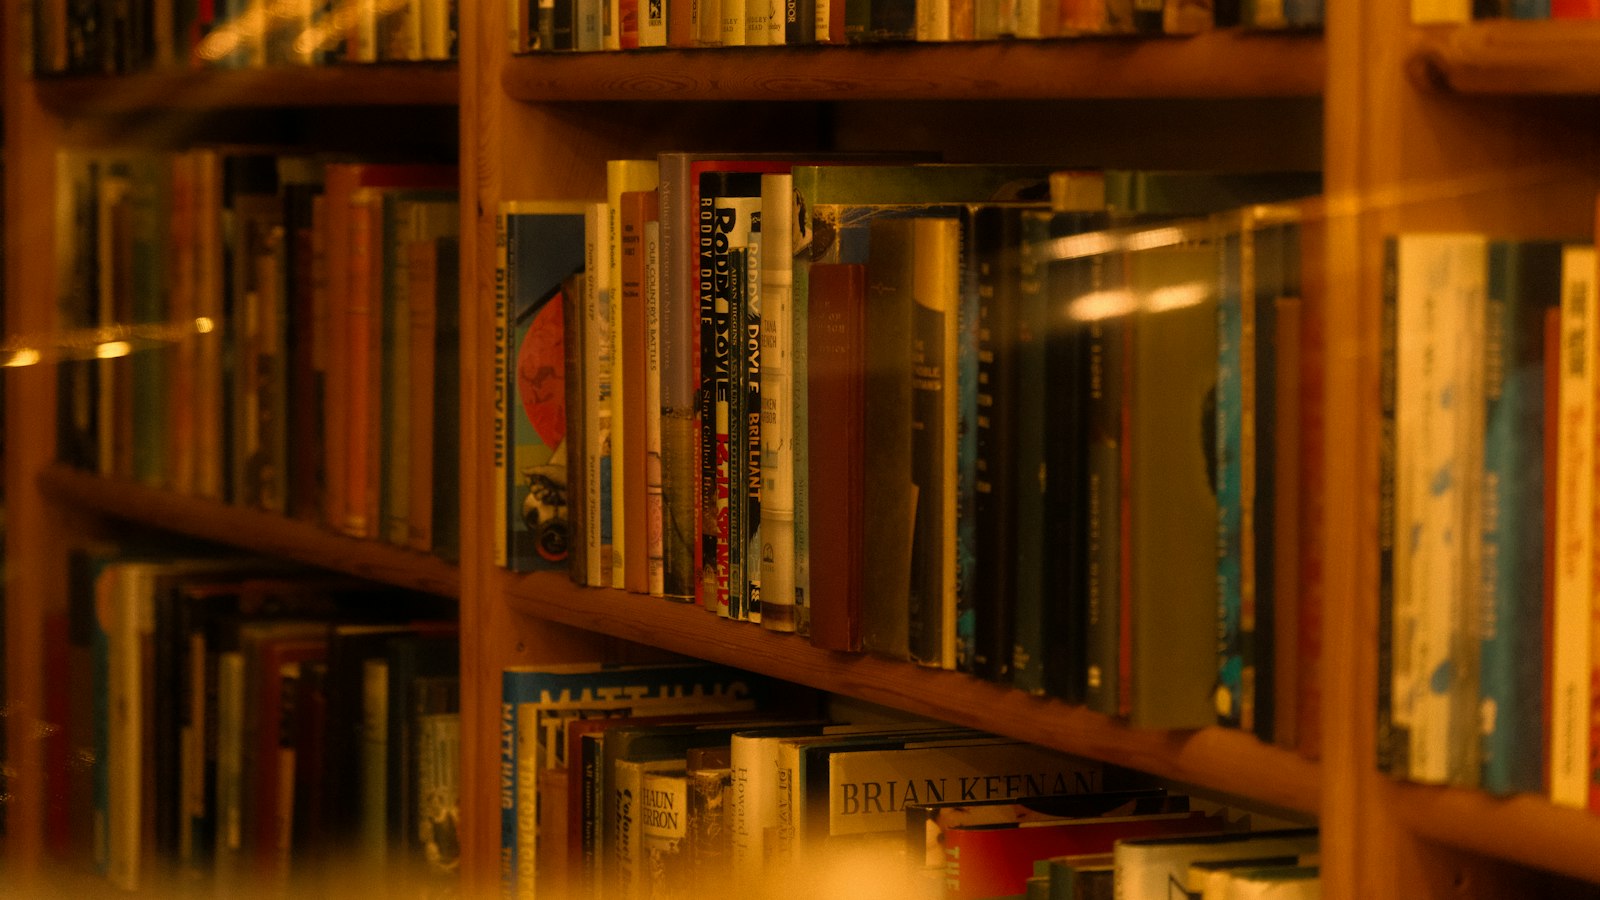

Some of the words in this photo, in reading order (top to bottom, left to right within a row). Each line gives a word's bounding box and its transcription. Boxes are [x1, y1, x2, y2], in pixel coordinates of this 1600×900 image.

[787, 0, 797, 23] DOR
[662, 180, 671, 230] Medical
[701, 197, 712, 258] RODDY
[663, 235, 671, 279] Doctor
[714, 208, 737, 299] RODDY
[701, 268, 712, 326] DOYLE
[747, 242, 759, 315] RODDY
[662, 300, 671, 335] Many
[715, 312, 730, 403] DOYLE
[747, 324, 760, 394] DOYLE
[703, 388, 711, 420] Star
[703, 425, 711, 470] Called
[747, 412, 761, 500] BRILLIANT
[702, 476, 711, 521] Henry
[501, 702, 513, 760] MATT
[501, 762, 513, 810] HAIG
[643, 788, 675, 811] HAUN
[737, 767, 749, 837] Howard
[840, 777, 947, 816] BRIAN
[958, 770, 1096, 801] KEENAN
[622, 788, 633, 865] Colonel
[643, 808, 679, 831] ERRON
[943, 846, 961, 892] THE
